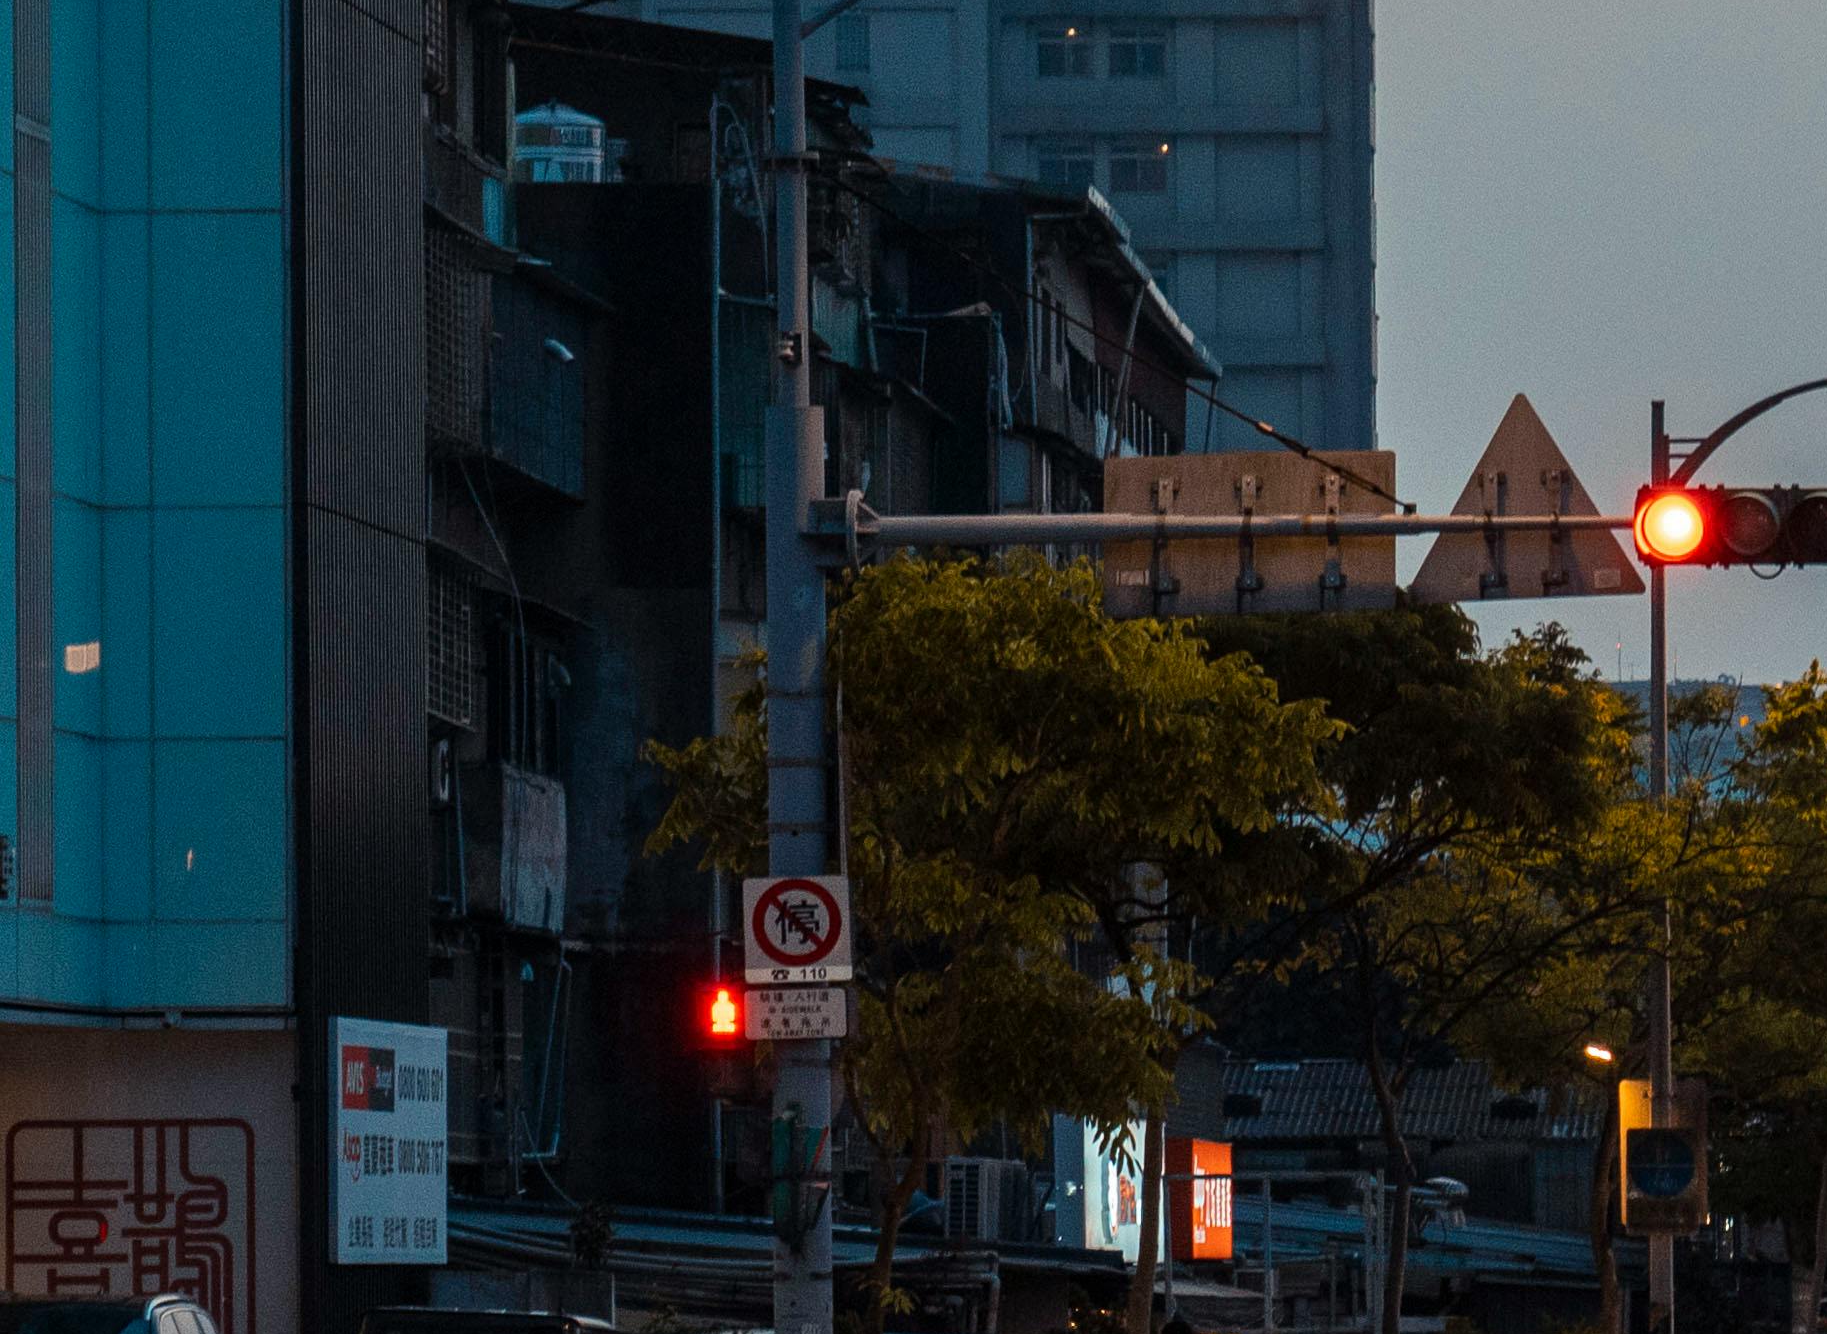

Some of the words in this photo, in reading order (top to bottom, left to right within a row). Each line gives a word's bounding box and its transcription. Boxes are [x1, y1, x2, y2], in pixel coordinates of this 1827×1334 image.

[774, 899, 821, 945] 停
[800, 968, 828, 980] 110
[346, 1062, 365, 1096] AVIS
